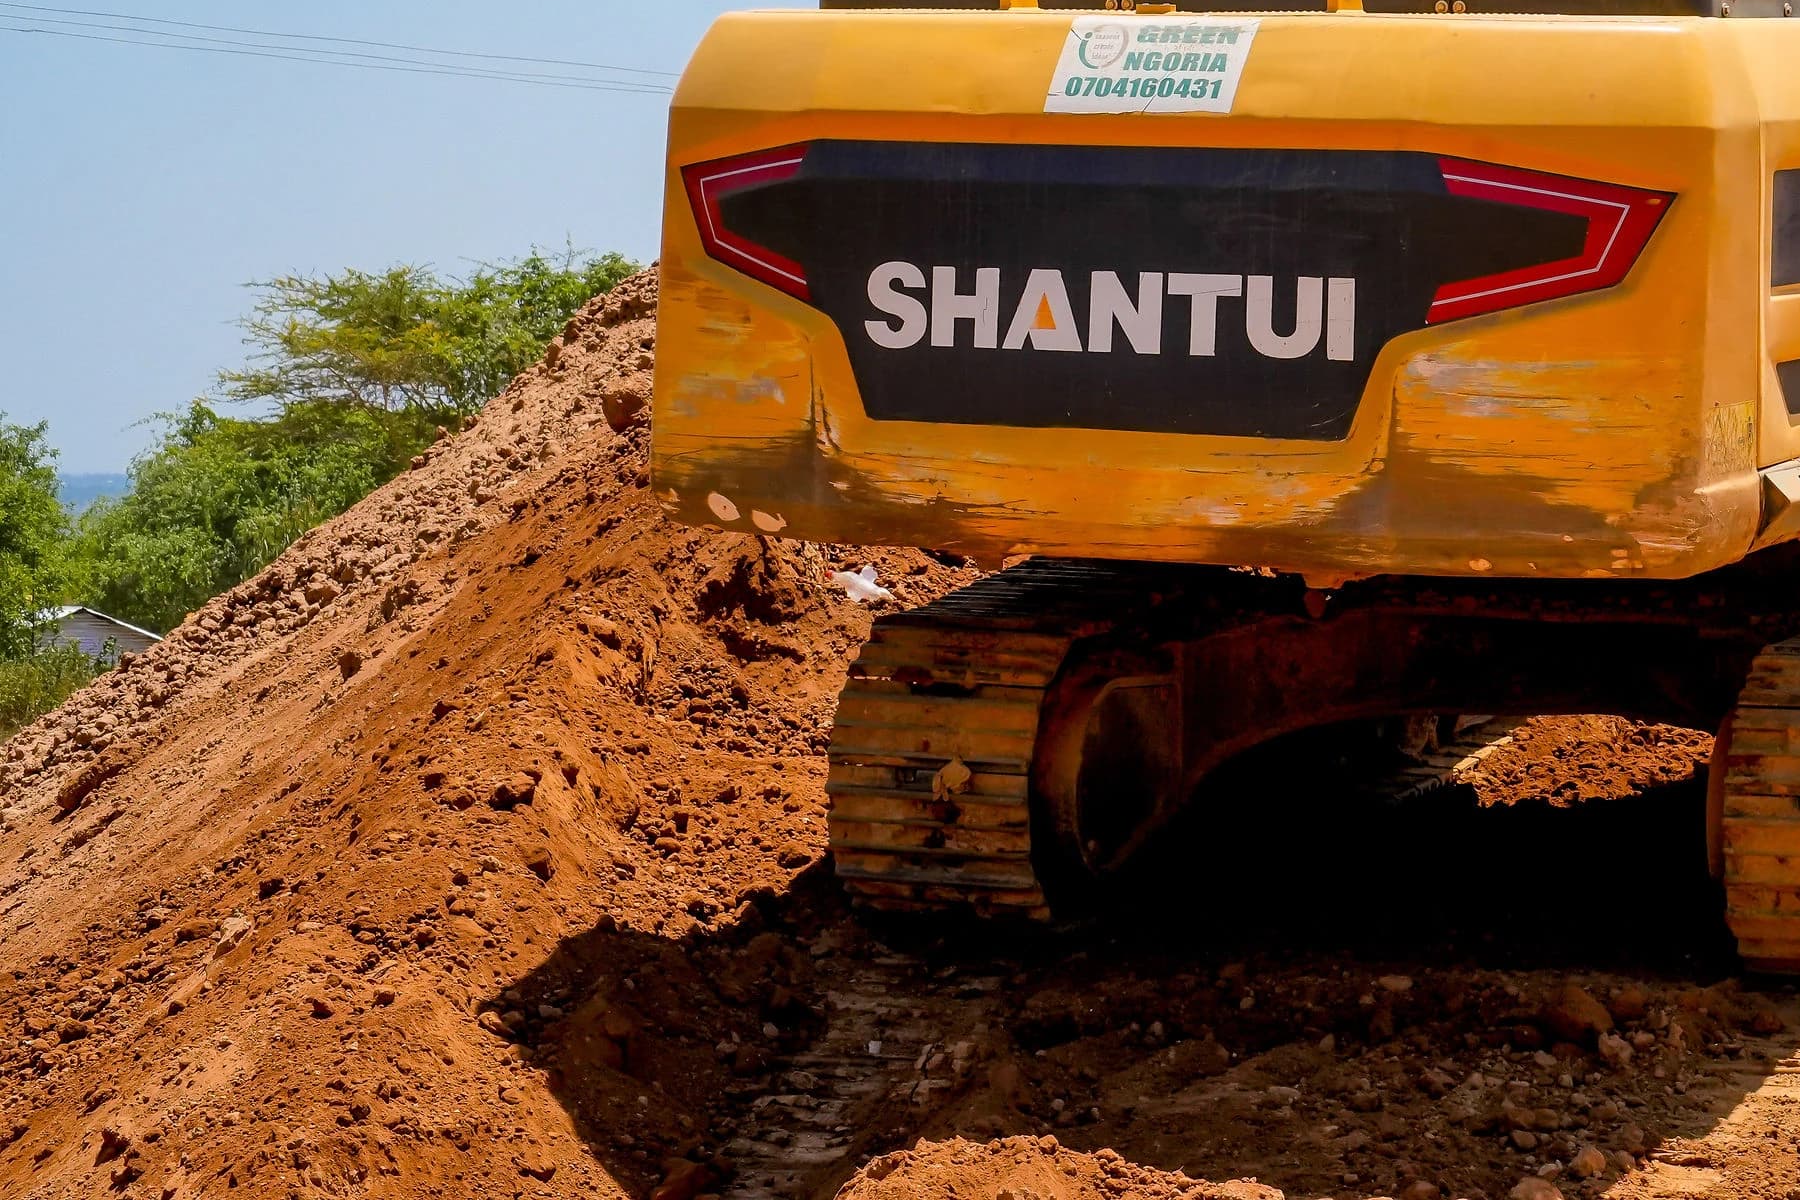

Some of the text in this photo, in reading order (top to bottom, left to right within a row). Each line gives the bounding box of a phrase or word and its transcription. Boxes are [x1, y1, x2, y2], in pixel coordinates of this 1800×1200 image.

[1136, 24, 1242, 45] GREEN
[1123, 52, 1228, 72] NGORIA
[1065, 76, 1223, 99] 0704160431
[864, 260, 1356, 361] SHANTUI
